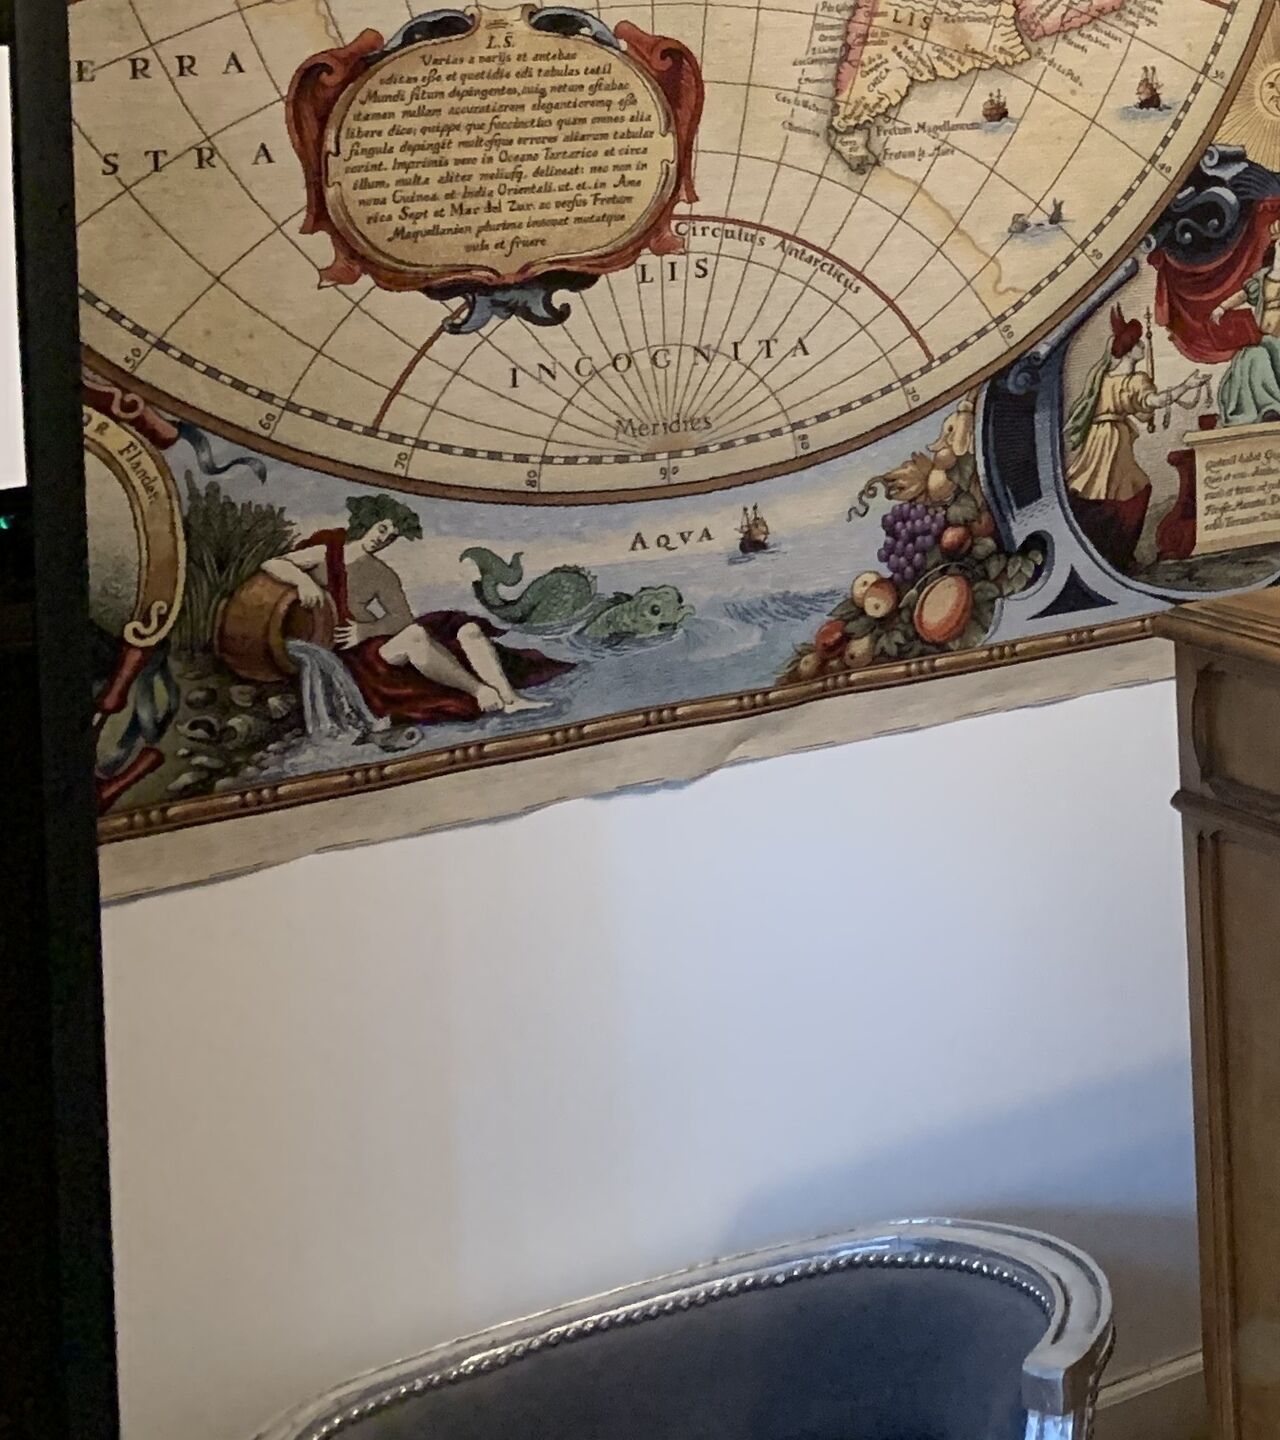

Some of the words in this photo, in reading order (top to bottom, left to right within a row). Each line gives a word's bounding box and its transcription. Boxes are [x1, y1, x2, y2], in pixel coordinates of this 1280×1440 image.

[637, 258, 710, 284] LIS
[509, 338, 811, 389] INCOGNITA
[614, 415, 714, 441] Meridies
[630, 526, 714, 552] AQVA
